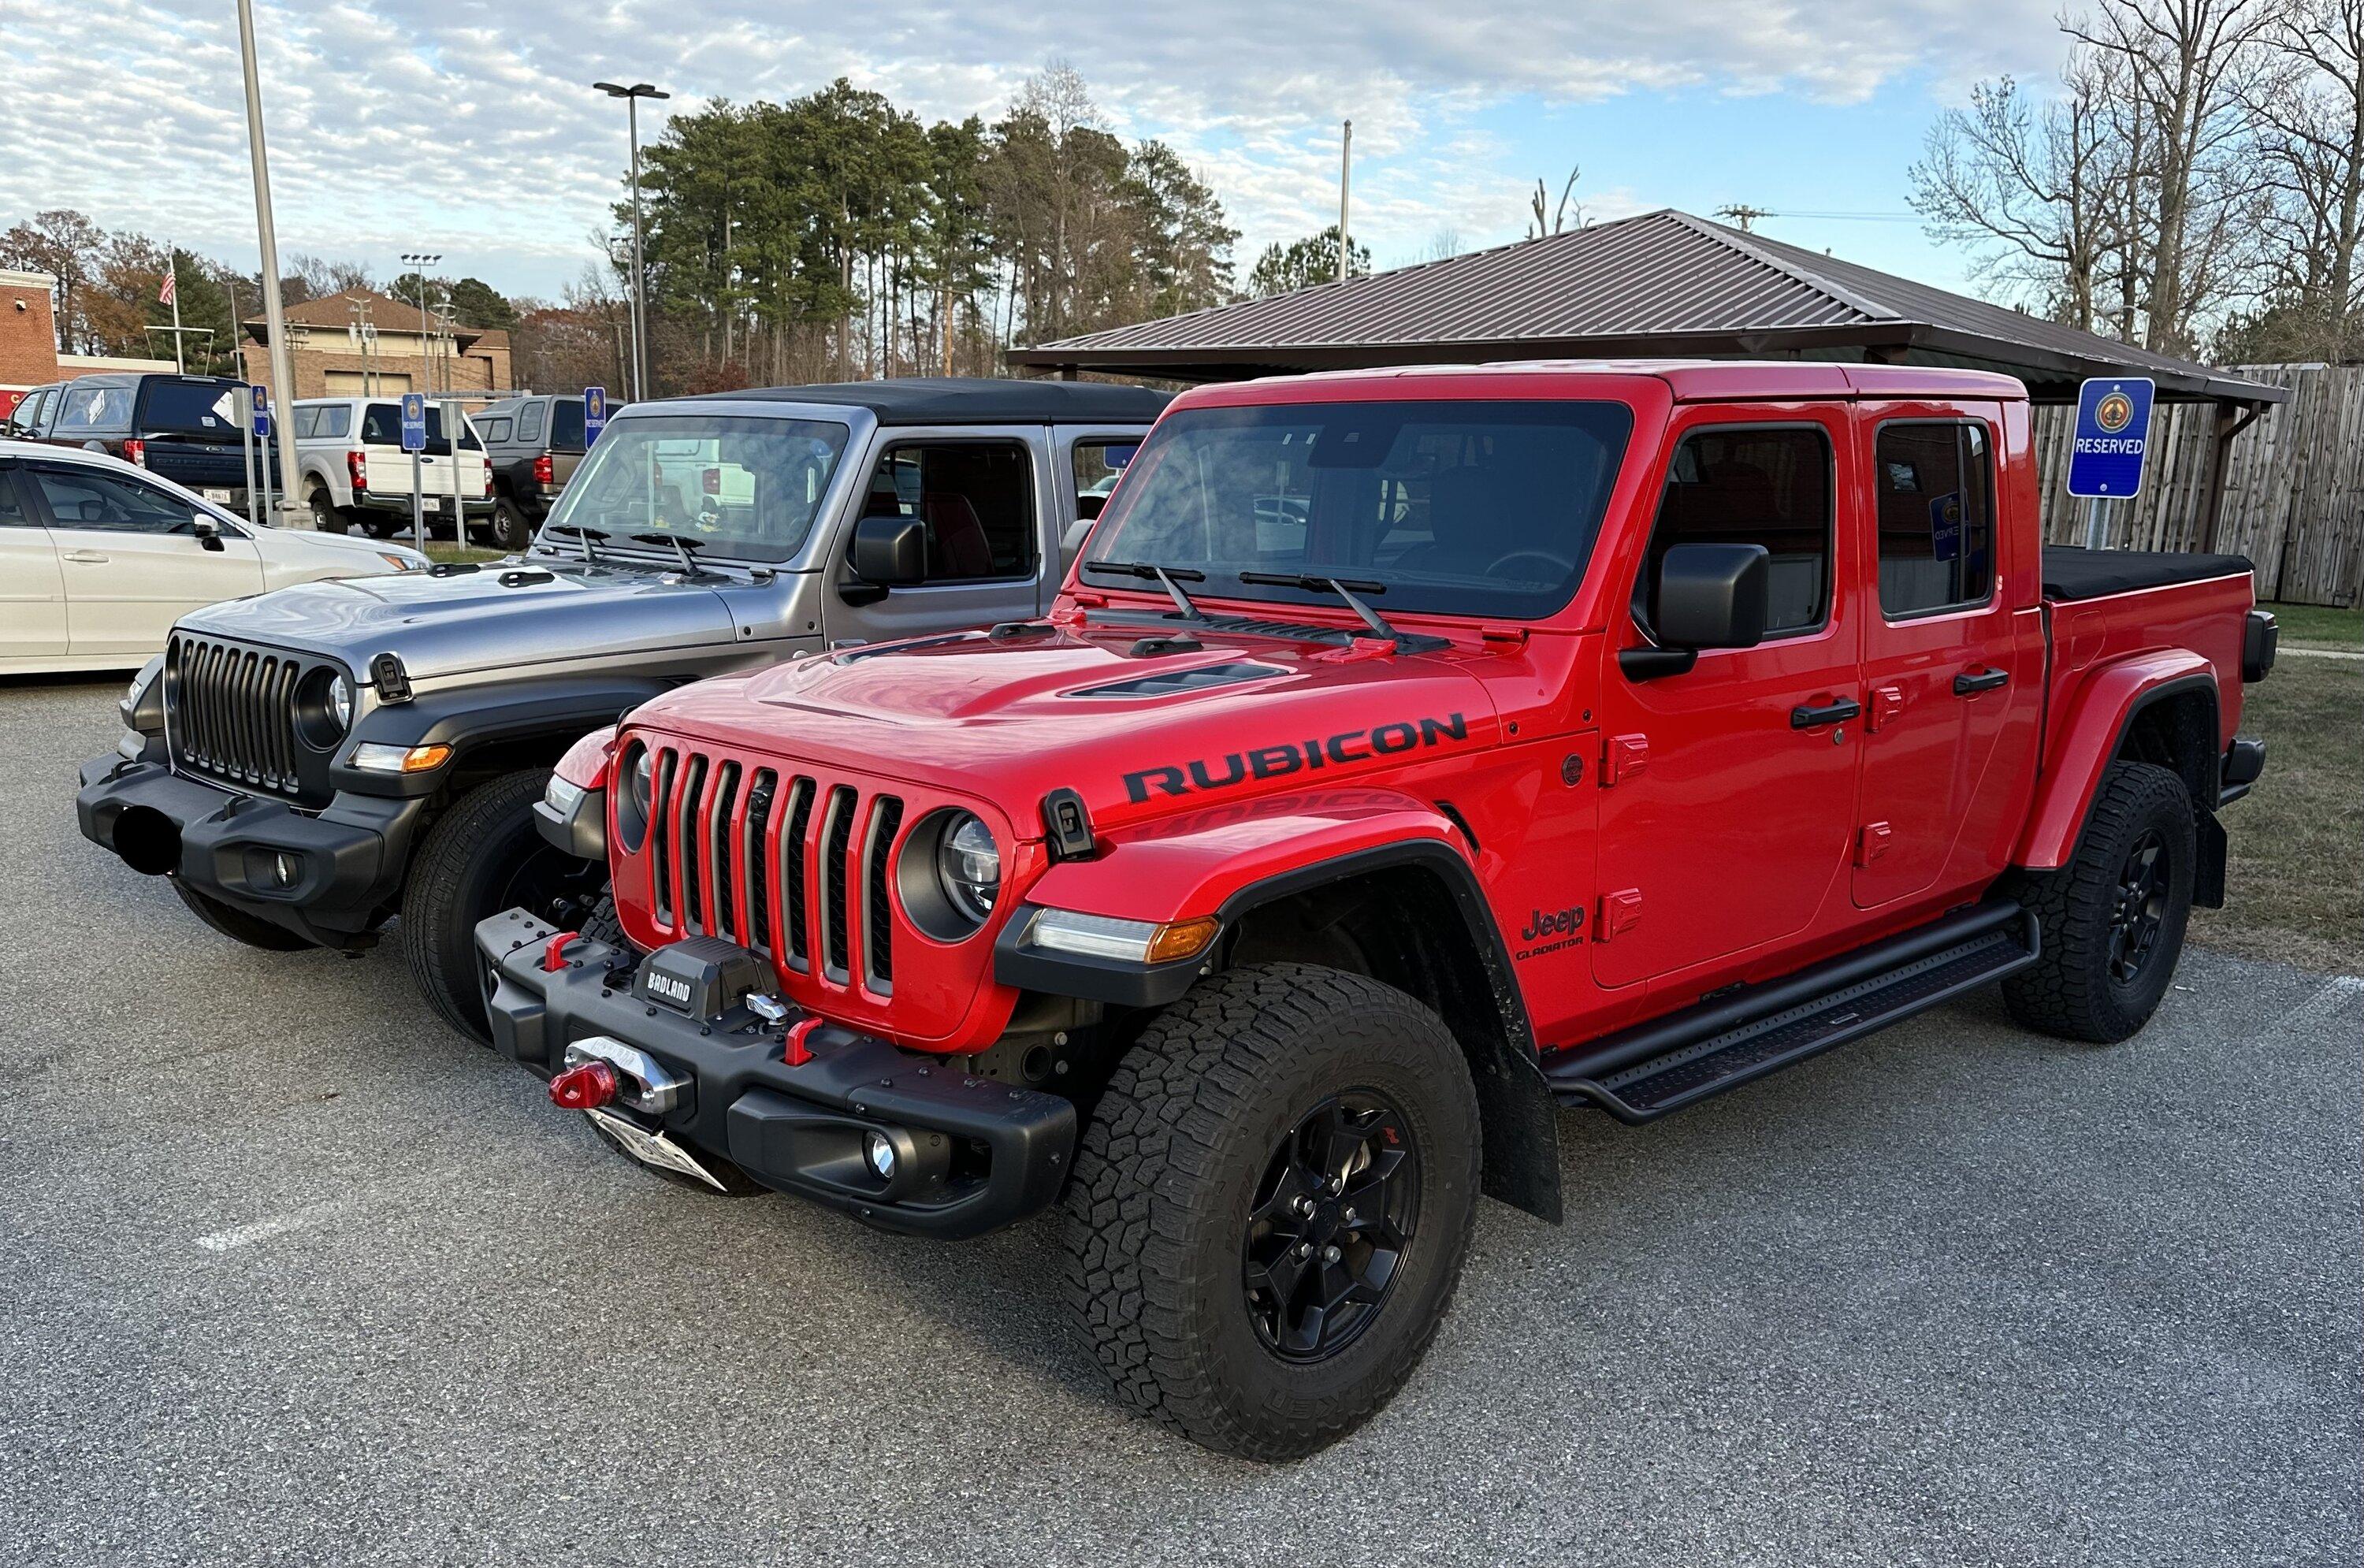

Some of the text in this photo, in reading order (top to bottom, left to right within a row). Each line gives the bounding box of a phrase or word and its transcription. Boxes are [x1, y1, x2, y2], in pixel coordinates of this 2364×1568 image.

[2076, 438, 2144, 455] RESERVED
[1121, 712, 1467, 804] RUBICON
[1521, 905, 1585, 942] Jeep
[1515, 935, 1584, 961] GLADIATOR
[647, 972, 691, 1002] BADLAND
